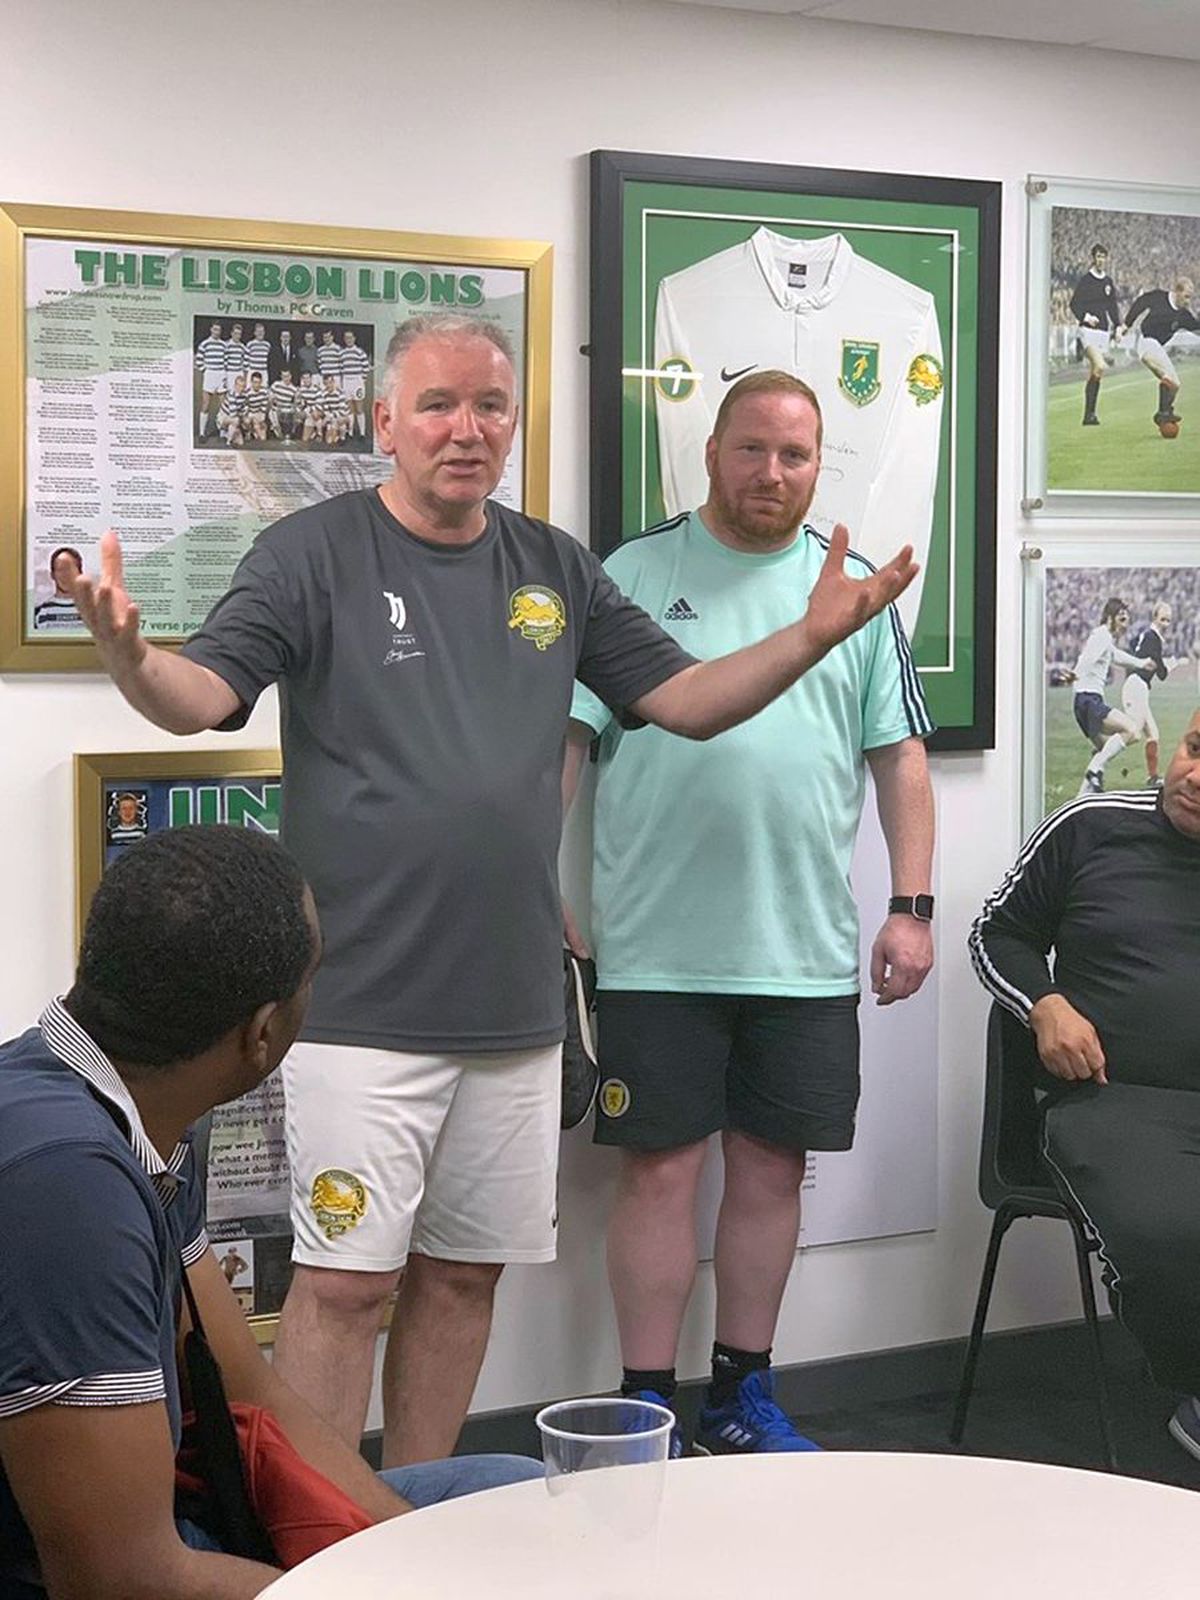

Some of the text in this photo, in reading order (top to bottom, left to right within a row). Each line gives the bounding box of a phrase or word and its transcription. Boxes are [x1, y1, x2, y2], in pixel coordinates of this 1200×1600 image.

[74, 249, 485, 306] THE LISBON LIONS
[217, 298, 354, 318] by Thomas PC Craven
[666, 364, 682, 395] 7
[664, 611, 699, 621] adidas
[150, 622, 179, 631] verse
[217, 1154, 241, 1164] what
[212, 1167, 250, 1177] without
[217, 1179, 242, 1190] Who
